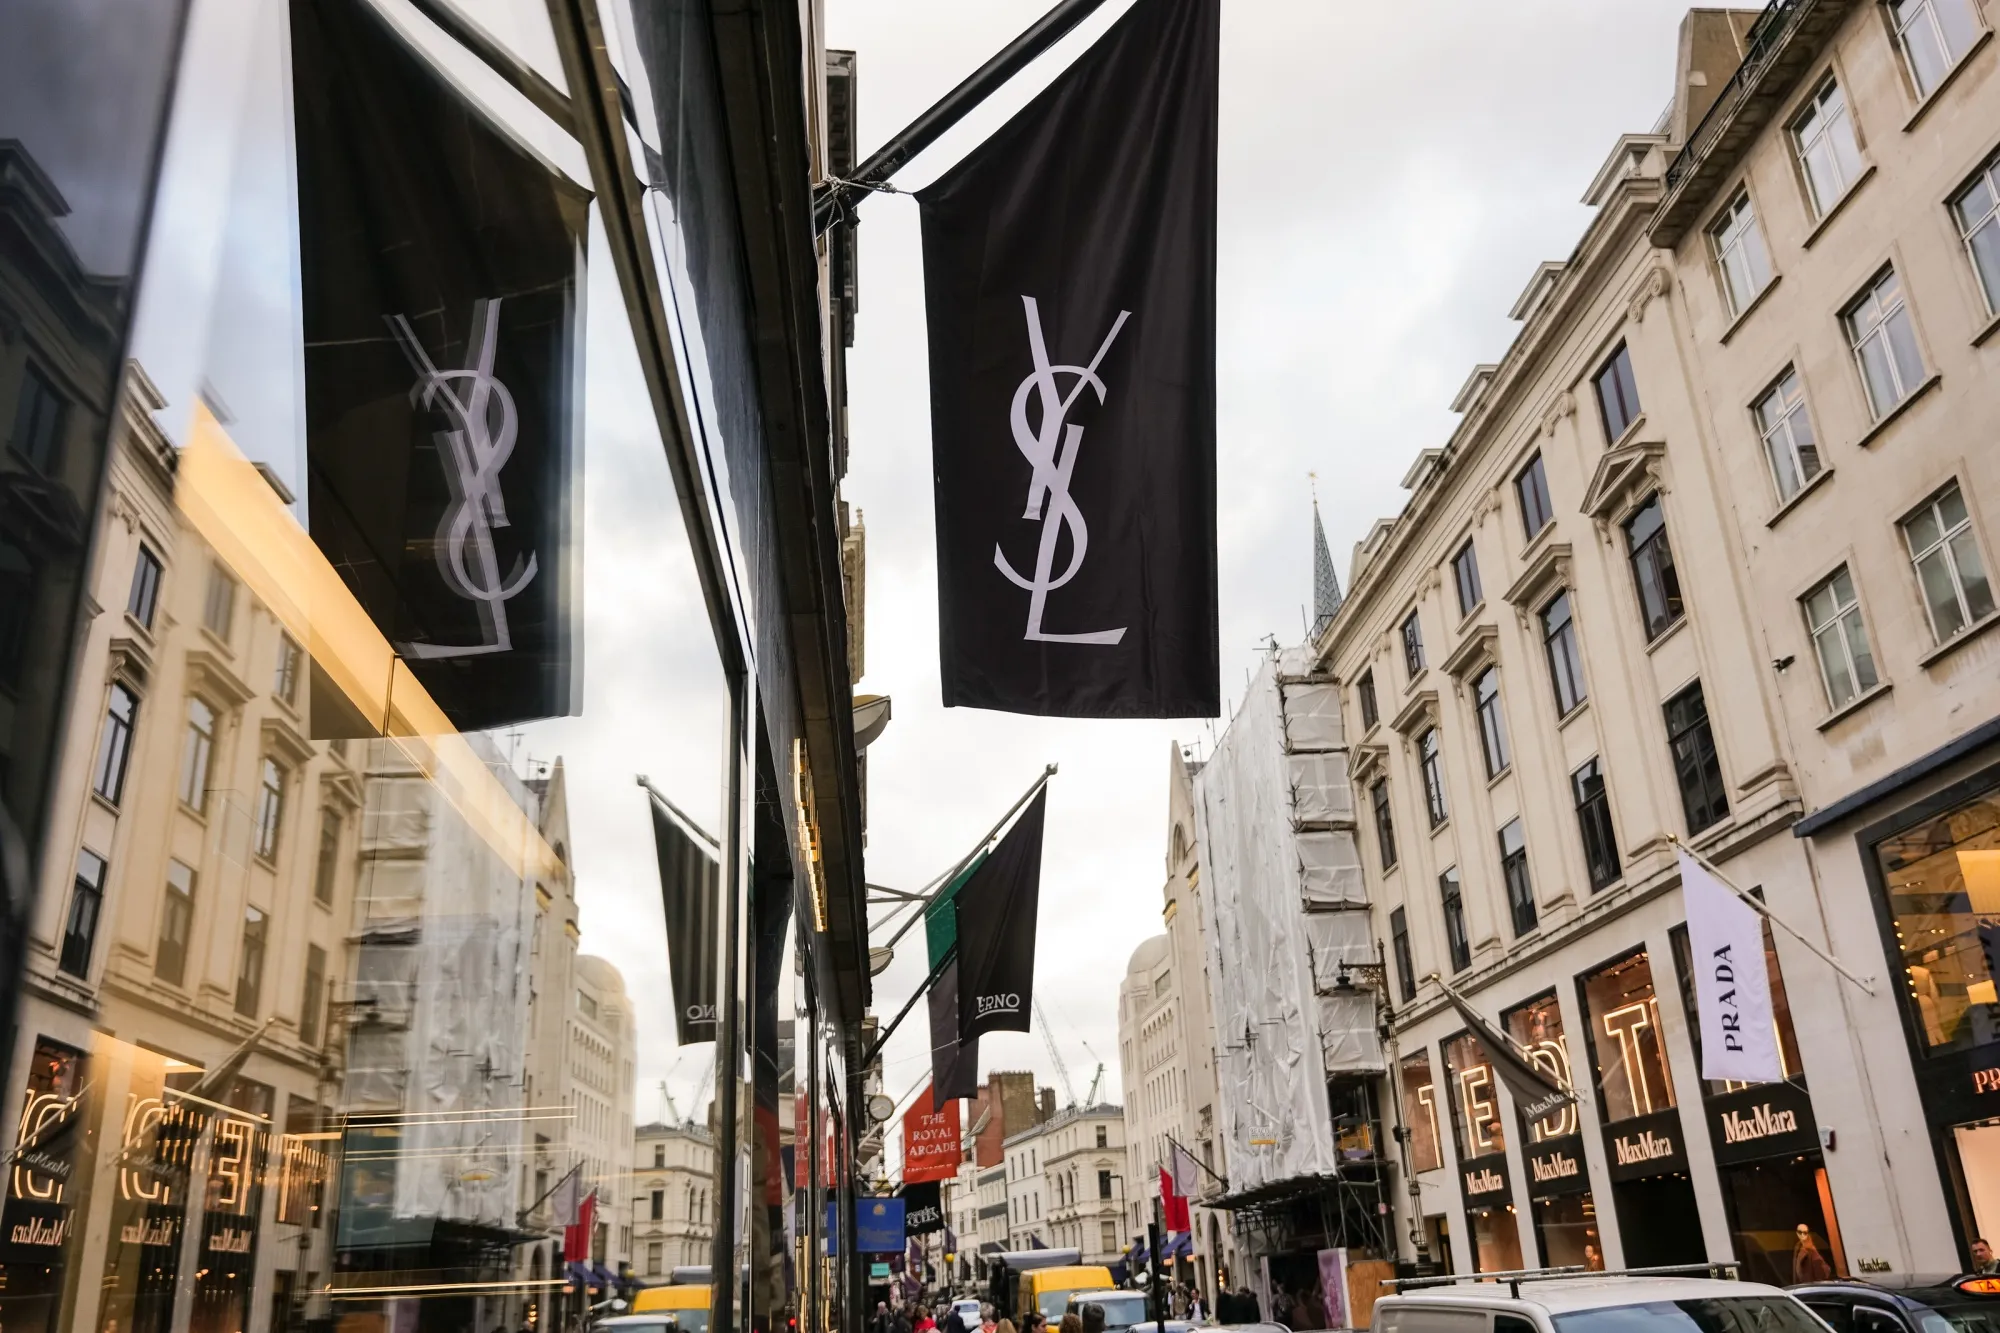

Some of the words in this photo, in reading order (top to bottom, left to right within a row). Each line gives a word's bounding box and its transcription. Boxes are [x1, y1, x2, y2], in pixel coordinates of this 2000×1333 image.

[993, 294, 1132, 645] YSL
[1713, 943, 1744, 1053] PRADA
[920, 1113, 945, 1126] THE
[1524, 1093, 1564, 1118] MaxMar
[913, 1127, 952, 1141] ROYAL
[1720, 1103, 1797, 1144] MaxMara
[909, 1141, 957, 1156] ARCADE
[1614, 1130, 1673, 1166] MaxMara
[1531, 1151, 1578, 1182] MaxMara
[1465, 1168, 1504, 1195] MaxMara
